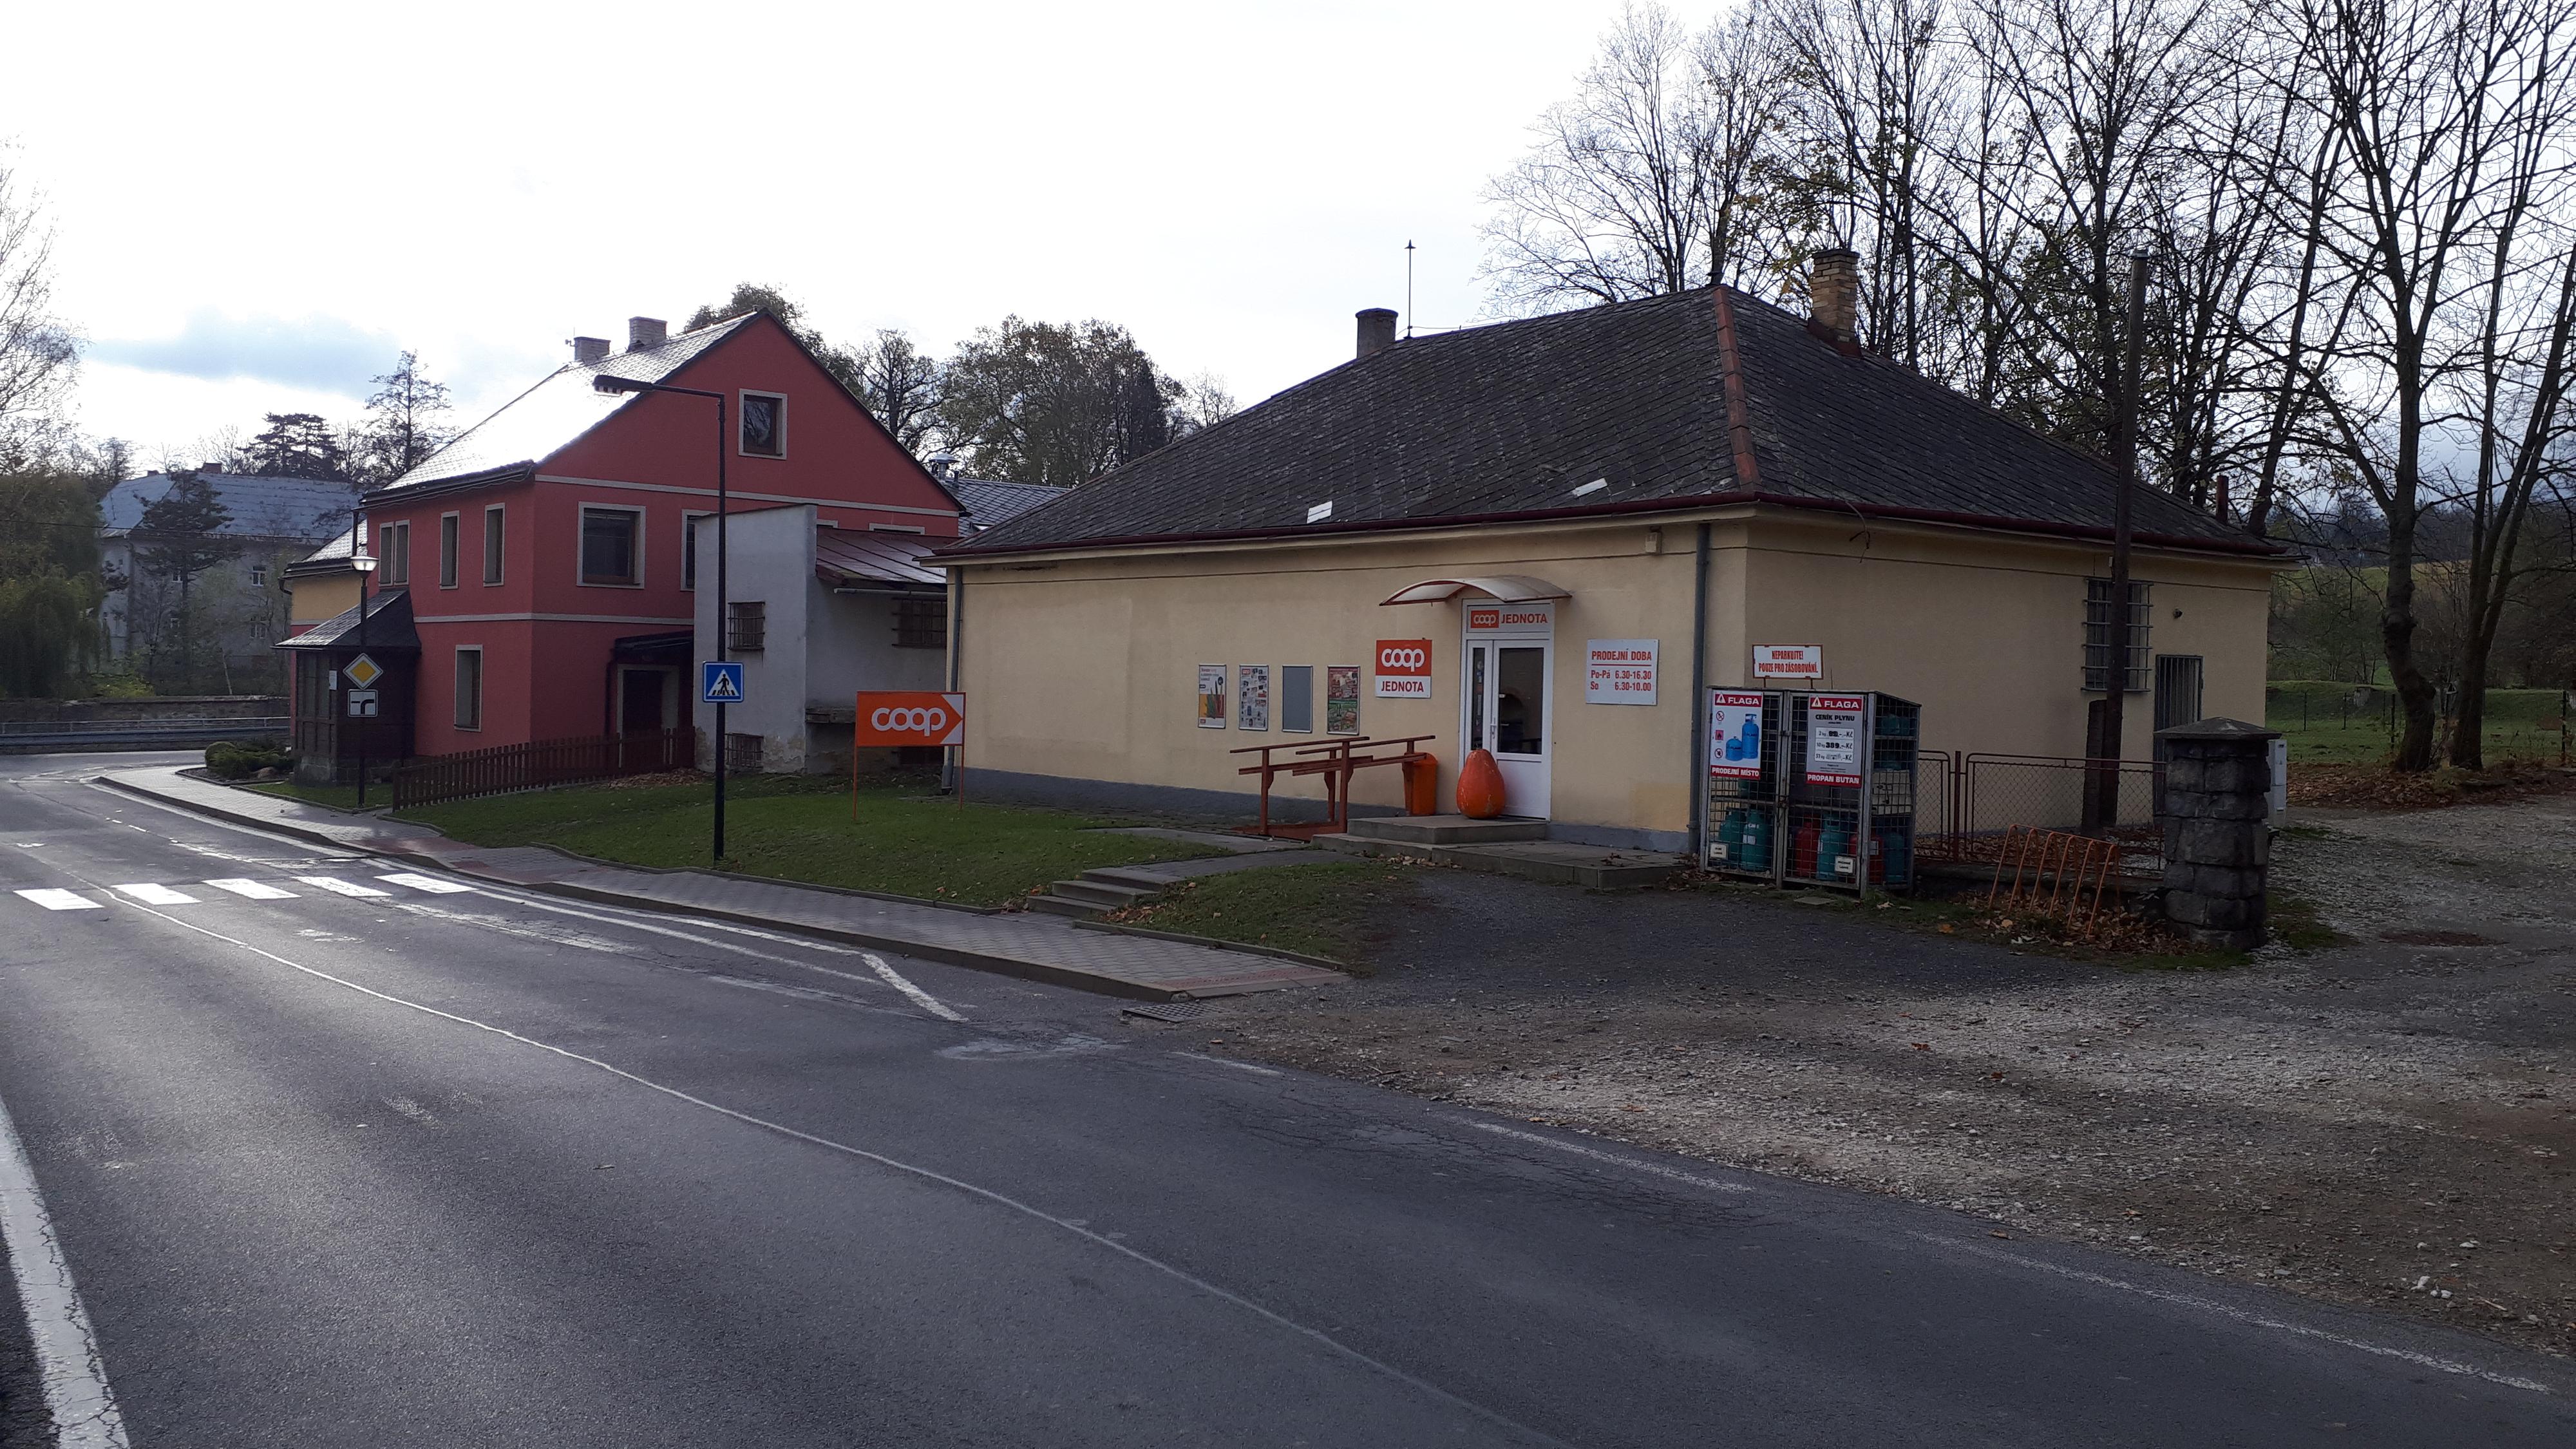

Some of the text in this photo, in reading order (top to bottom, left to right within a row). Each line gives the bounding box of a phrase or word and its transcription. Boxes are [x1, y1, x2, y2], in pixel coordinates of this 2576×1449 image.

[1501, 613, 1548, 623] JEDNOTA
[1591, 648, 1652, 661] PRODEJNÍ DOBA
[1759, 663, 1774, 672] POUZE
[1774, 663, 1785, 672] PRO
[1615, 670, 1652, 679] 6.30-16.30
[1381, 681, 1424, 692] JEDNOTA
[1590, 681, 1652, 691] So 6.30-10.00
[1824, 700, 1859, 708] FLAGA
[1807, 774, 1860, 784] PROPAN BUTAN
